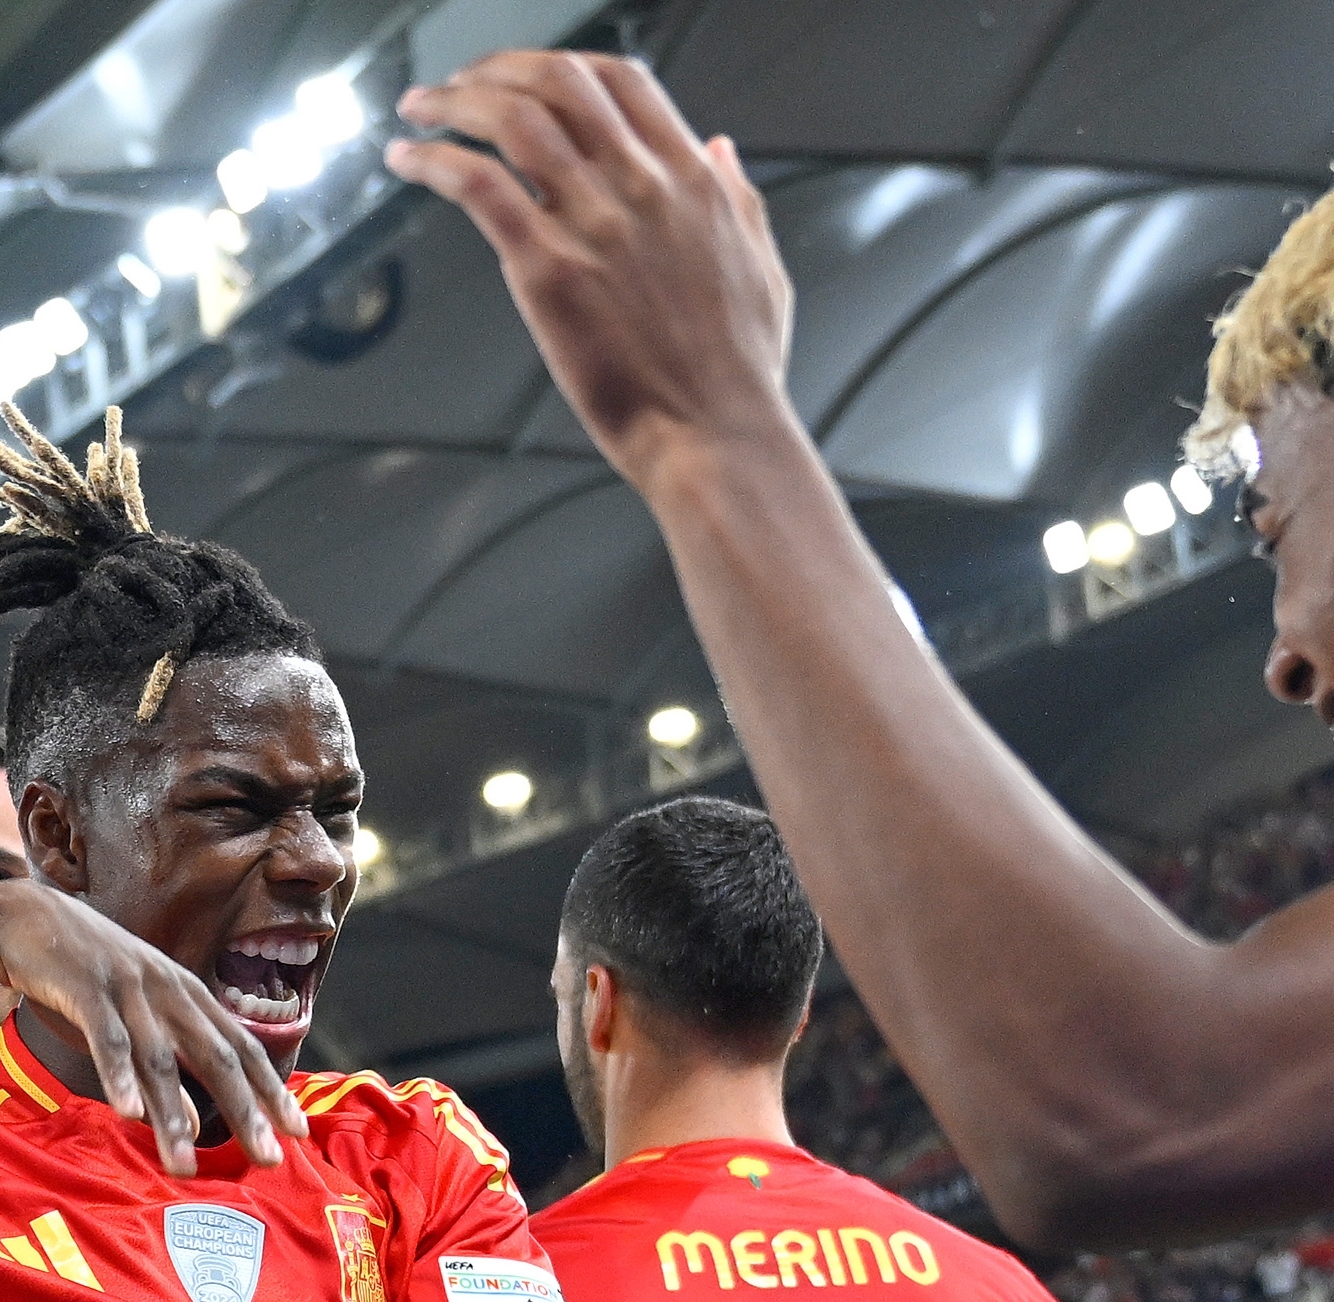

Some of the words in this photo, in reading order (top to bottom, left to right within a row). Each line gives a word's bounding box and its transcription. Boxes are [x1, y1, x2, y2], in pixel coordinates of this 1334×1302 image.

[197, 1212, 231, 1228] UEFA
[173, 1221, 255, 1247] EUROPEAN
[173, 1235, 255, 1259] CHAMPIONS
[655, 1227, 940, 1291] MERINO
[445, 1261, 474, 1271] UEFA
[448, 1276, 559, 1301] FOUNDATION
